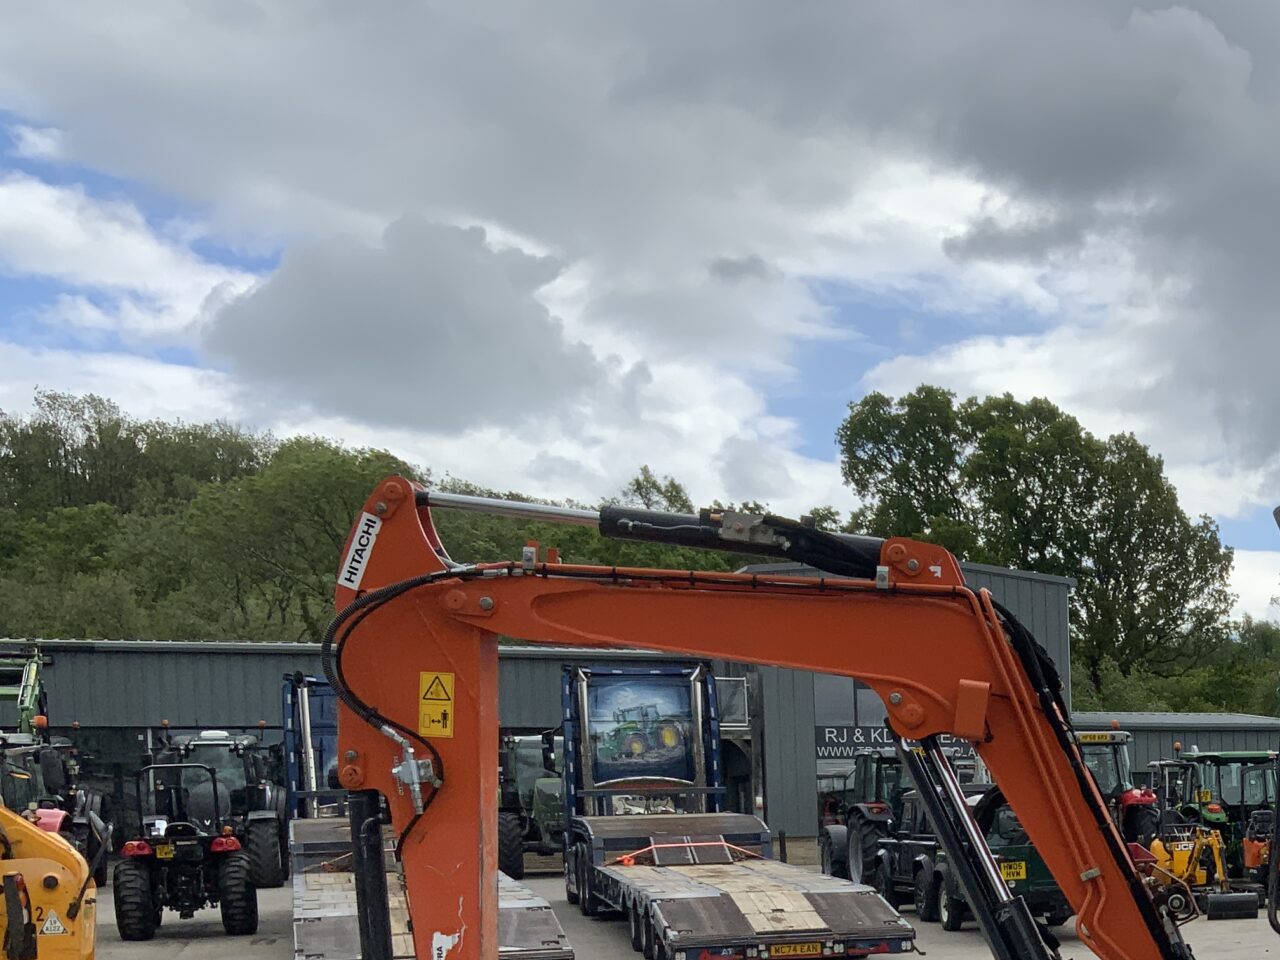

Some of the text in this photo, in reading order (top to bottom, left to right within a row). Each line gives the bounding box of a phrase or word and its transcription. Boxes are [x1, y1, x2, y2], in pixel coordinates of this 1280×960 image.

[344, 518, 377, 584] HITACHI
[825, 728, 847, 743] RJ
[853, 728, 865, 743] &
